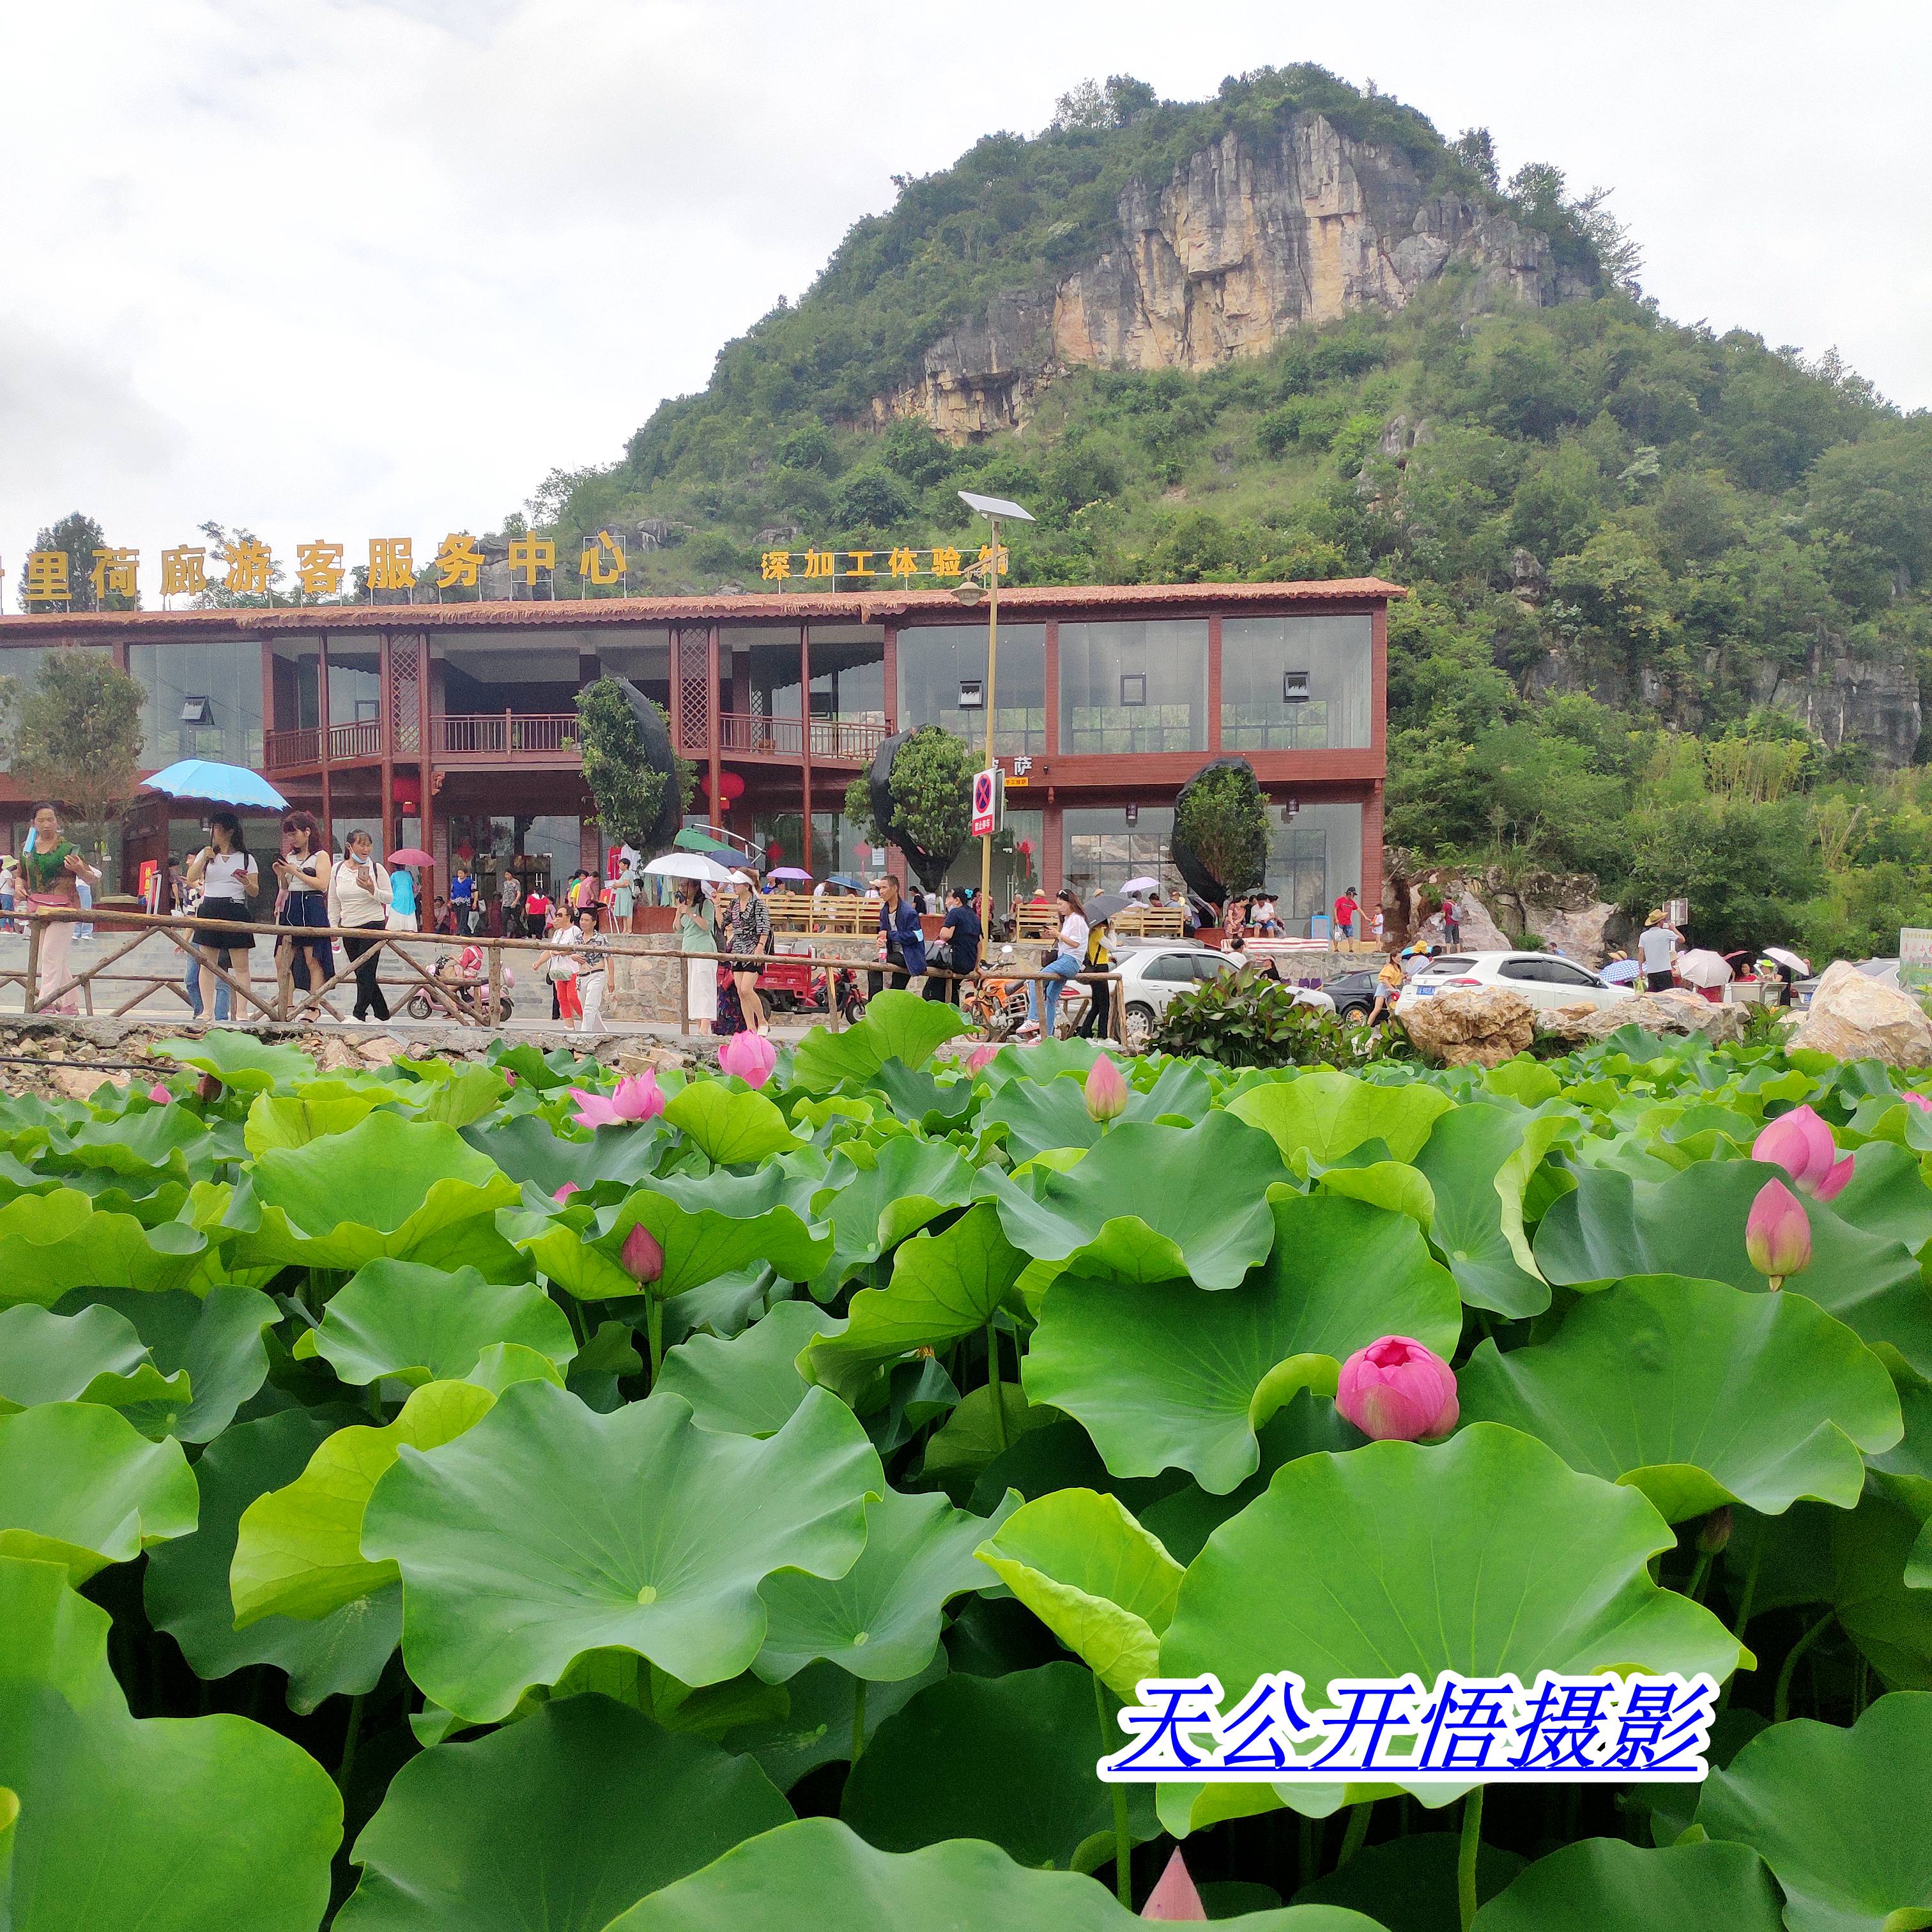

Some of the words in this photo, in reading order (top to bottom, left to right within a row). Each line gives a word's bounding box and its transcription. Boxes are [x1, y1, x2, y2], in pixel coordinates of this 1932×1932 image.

[0, 530, 627, 601] 里荷廊游客服务中心
